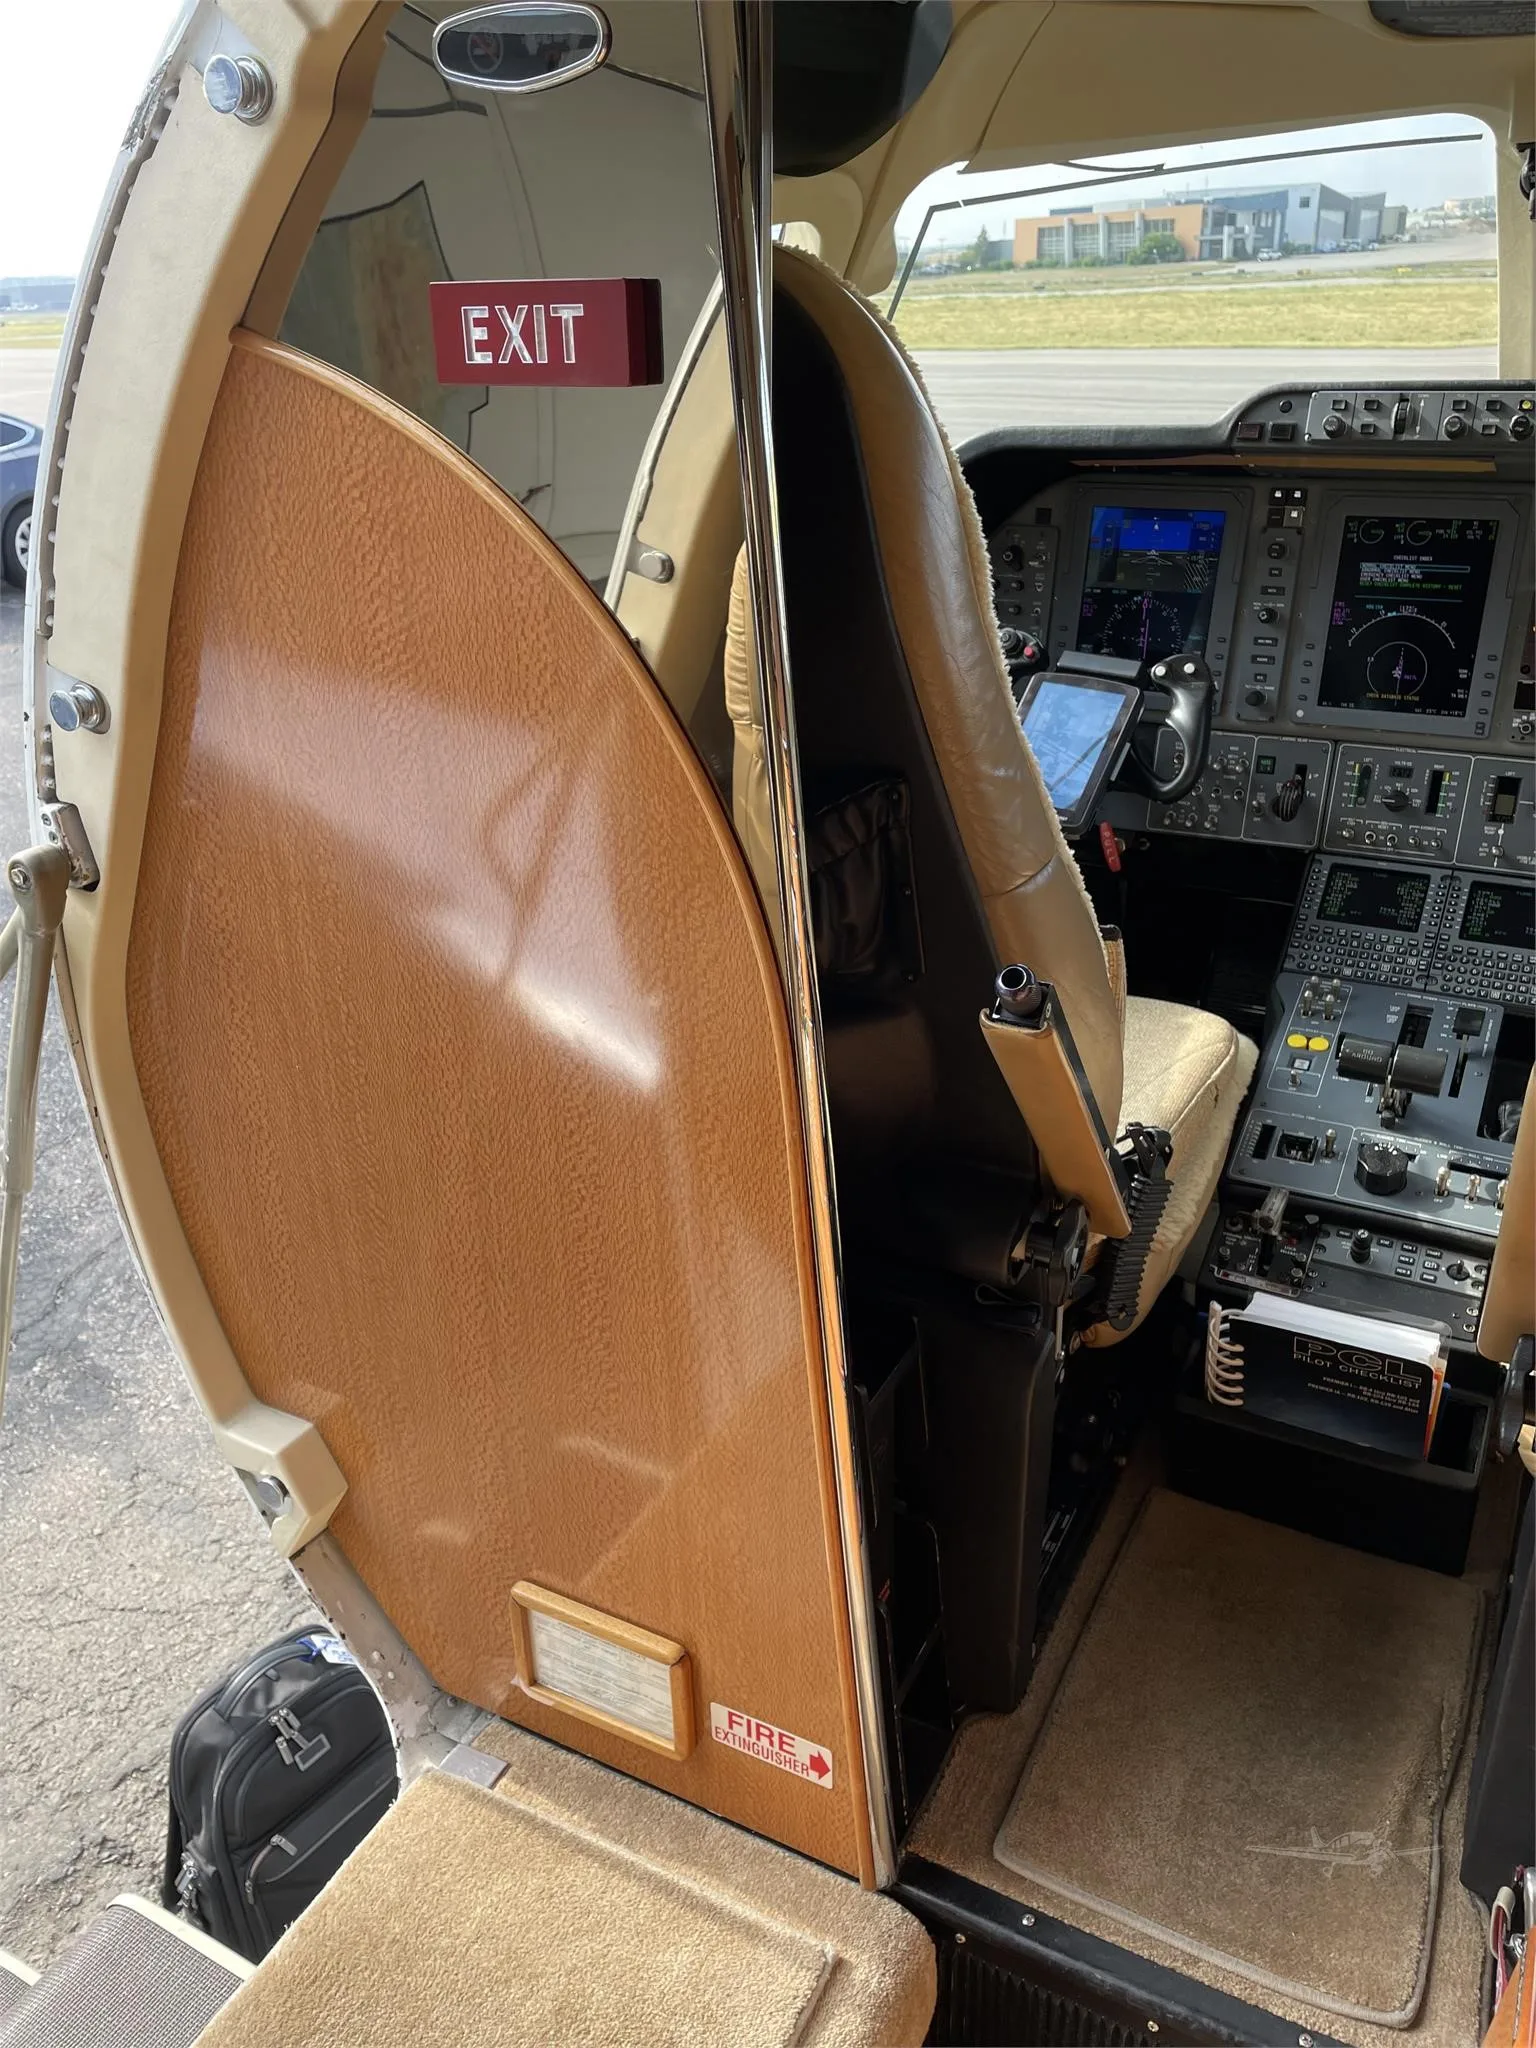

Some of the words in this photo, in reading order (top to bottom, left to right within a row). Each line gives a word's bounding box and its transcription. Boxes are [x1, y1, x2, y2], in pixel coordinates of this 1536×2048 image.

[461, 304, 584, 364] EXIT
[1294, 1336, 1422, 1383] PCL
[1294, 1353, 1333, 1368] PILOT
[1338, 1364, 1421, 1390] CHECKLIST
[714, 1726, 810, 1777] EXTINGUISHER
[727, 1710, 797, 1757] FIRE
